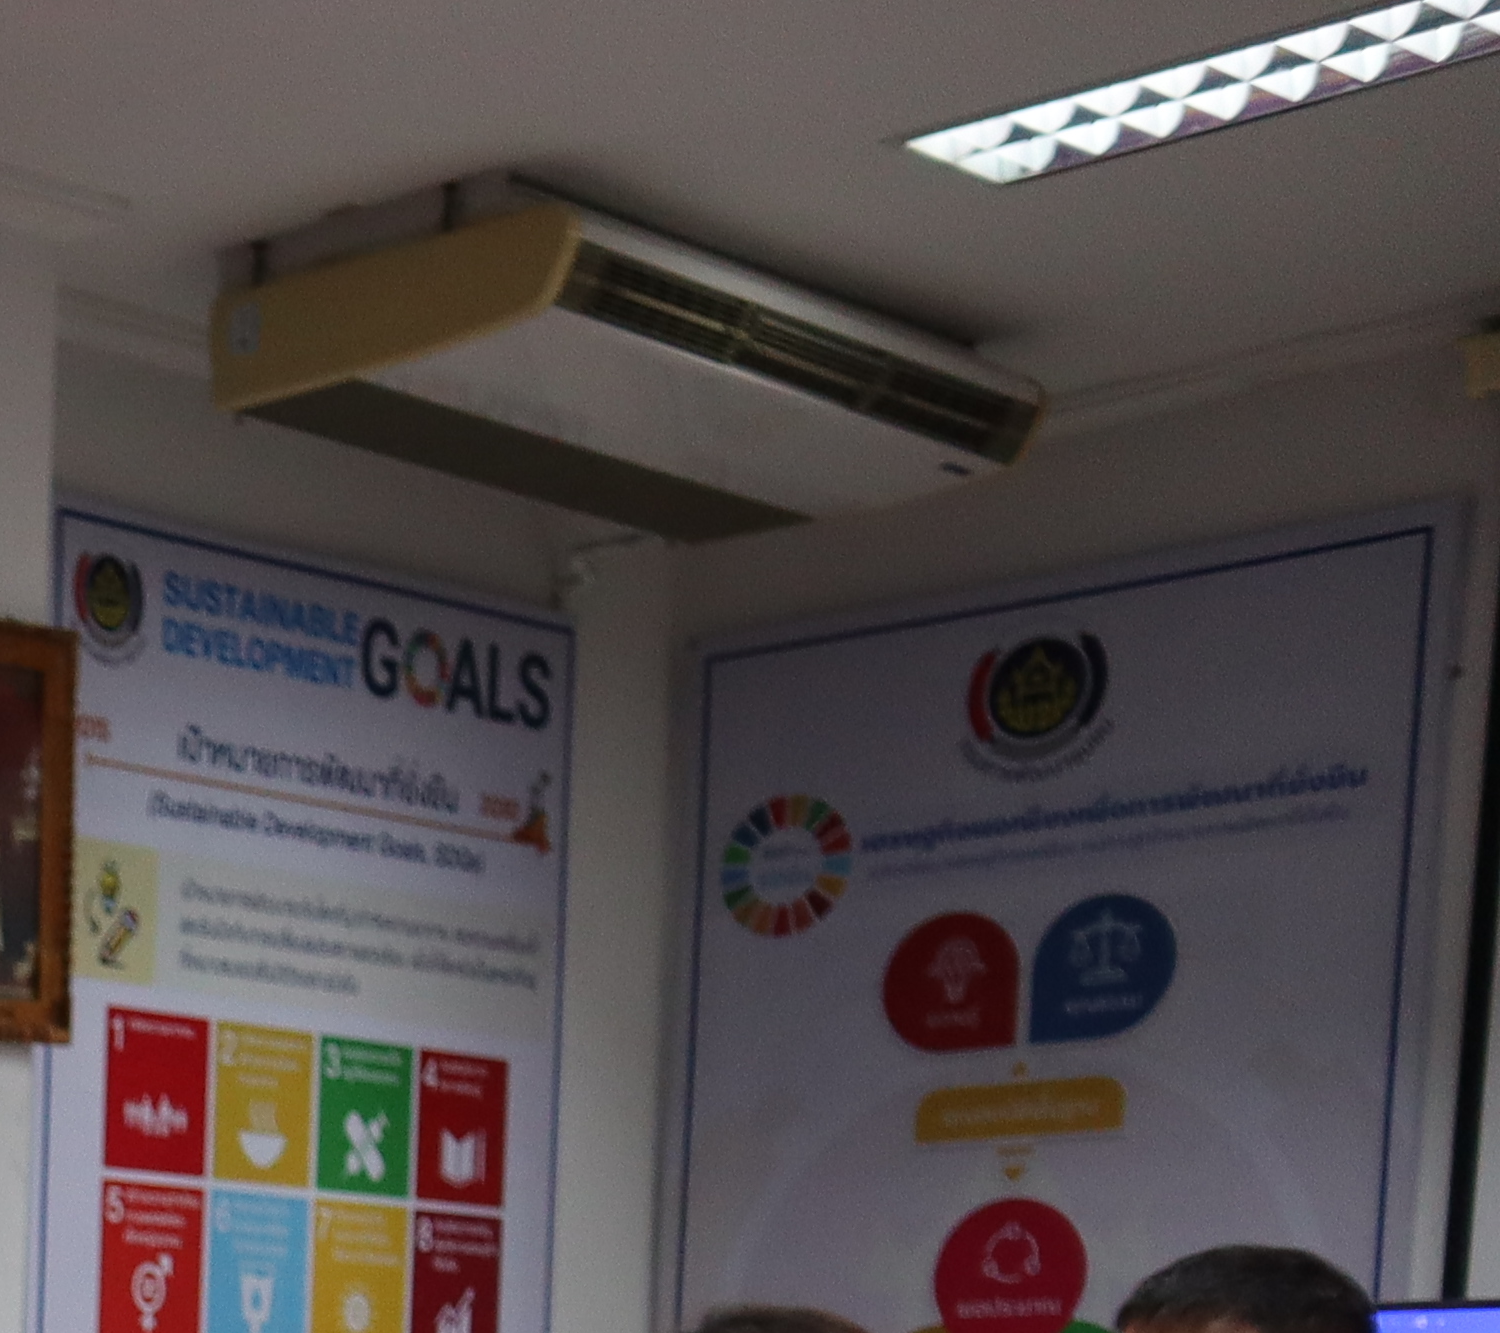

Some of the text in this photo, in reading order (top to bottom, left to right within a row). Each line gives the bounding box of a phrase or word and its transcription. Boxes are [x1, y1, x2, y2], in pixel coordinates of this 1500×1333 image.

[163, 569, 360, 646] SUSTAINABLE
[161, 617, 357, 688] DEVELOPMENT
[362, 617, 552, 730] GOALS
